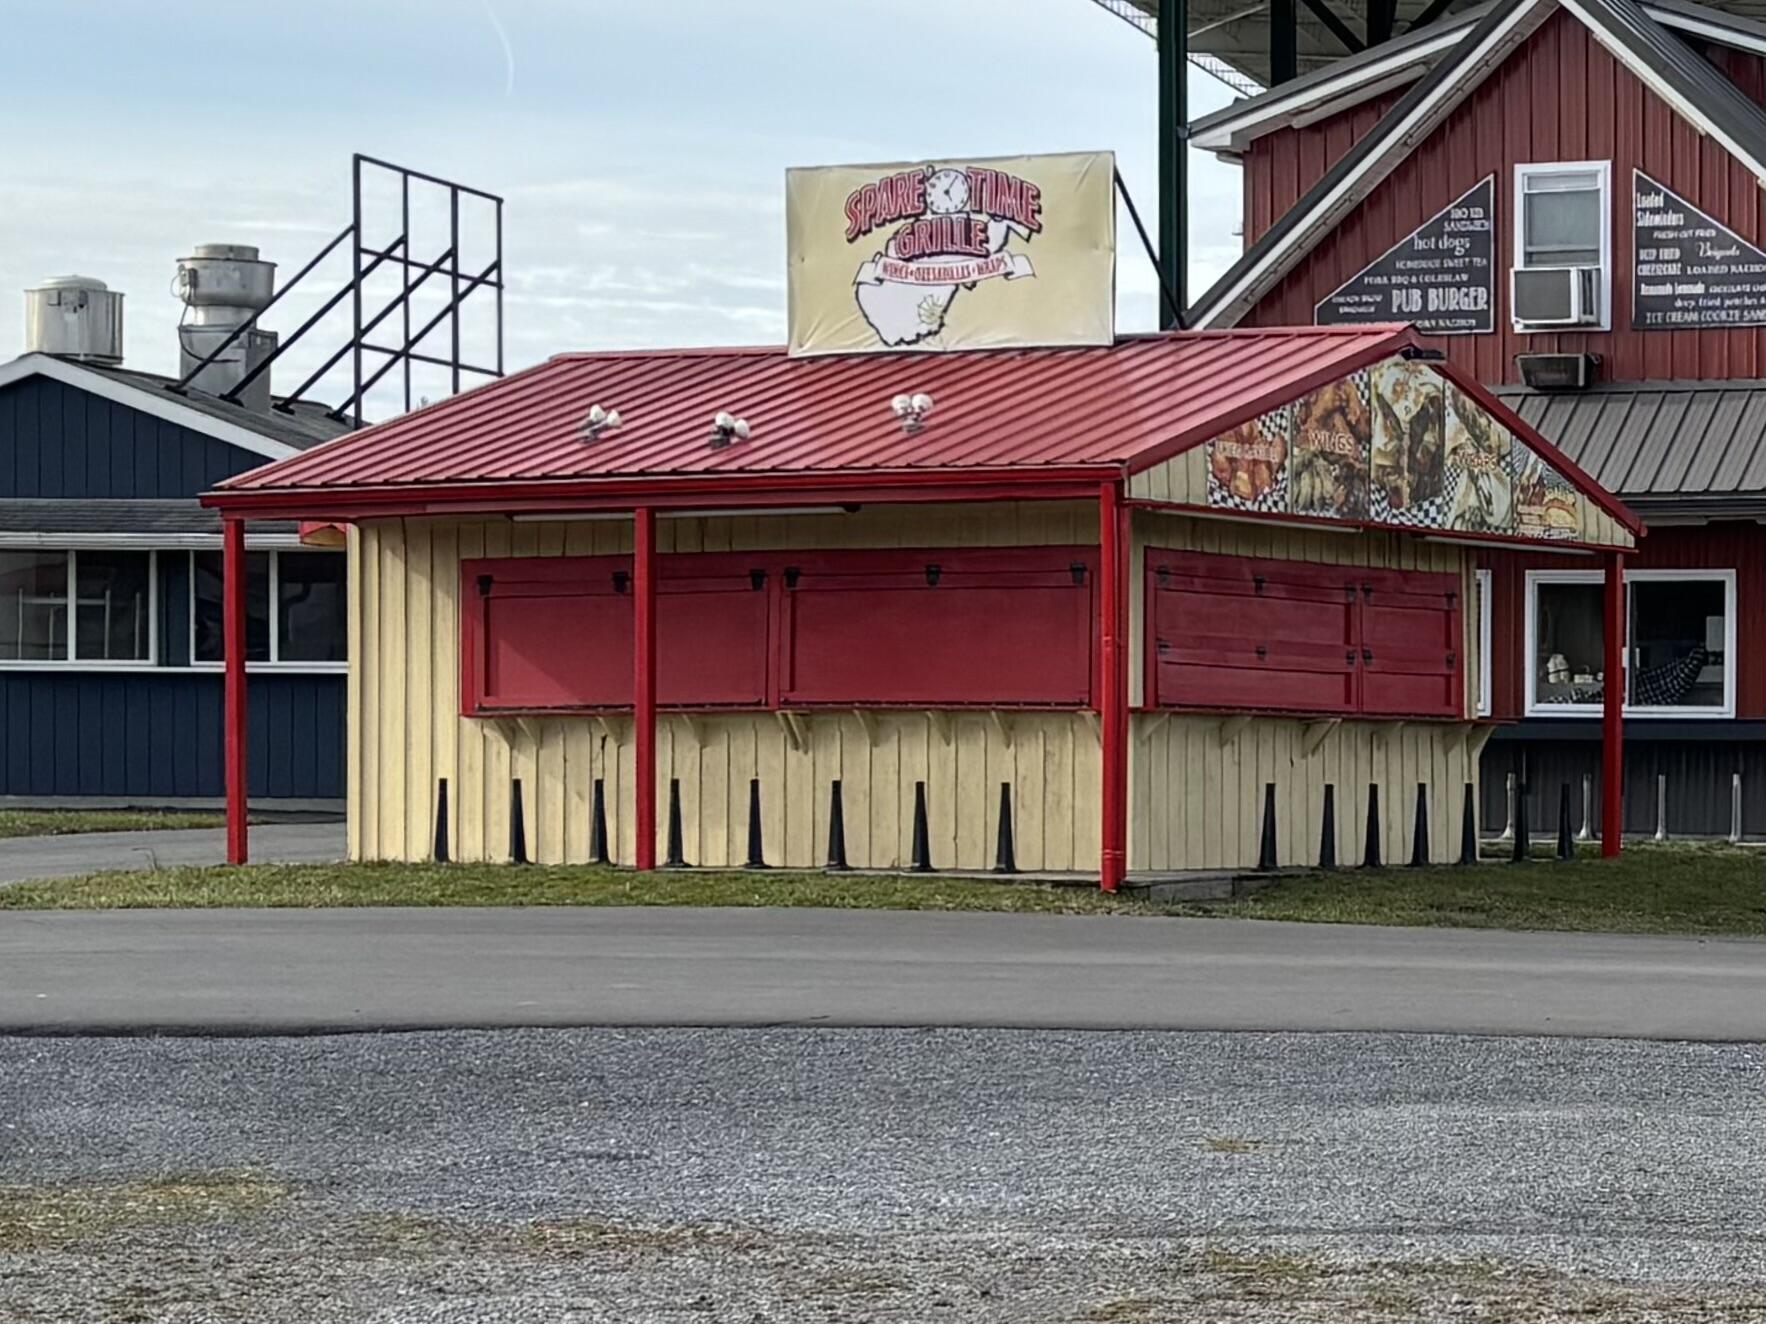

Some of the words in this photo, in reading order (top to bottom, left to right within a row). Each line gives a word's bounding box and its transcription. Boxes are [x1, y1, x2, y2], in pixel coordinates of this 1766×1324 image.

[845, 168, 927, 243] SPARE
[966, 166, 1041, 232] TIME
[896, 215, 990, 261] GRILLE
[1413, 234, 1436, 251] hot
[1438, 234, 1471, 256] dogs
[1391, 288, 1423, 313] PUB
[1427, 286, 1489, 312] BURGER
